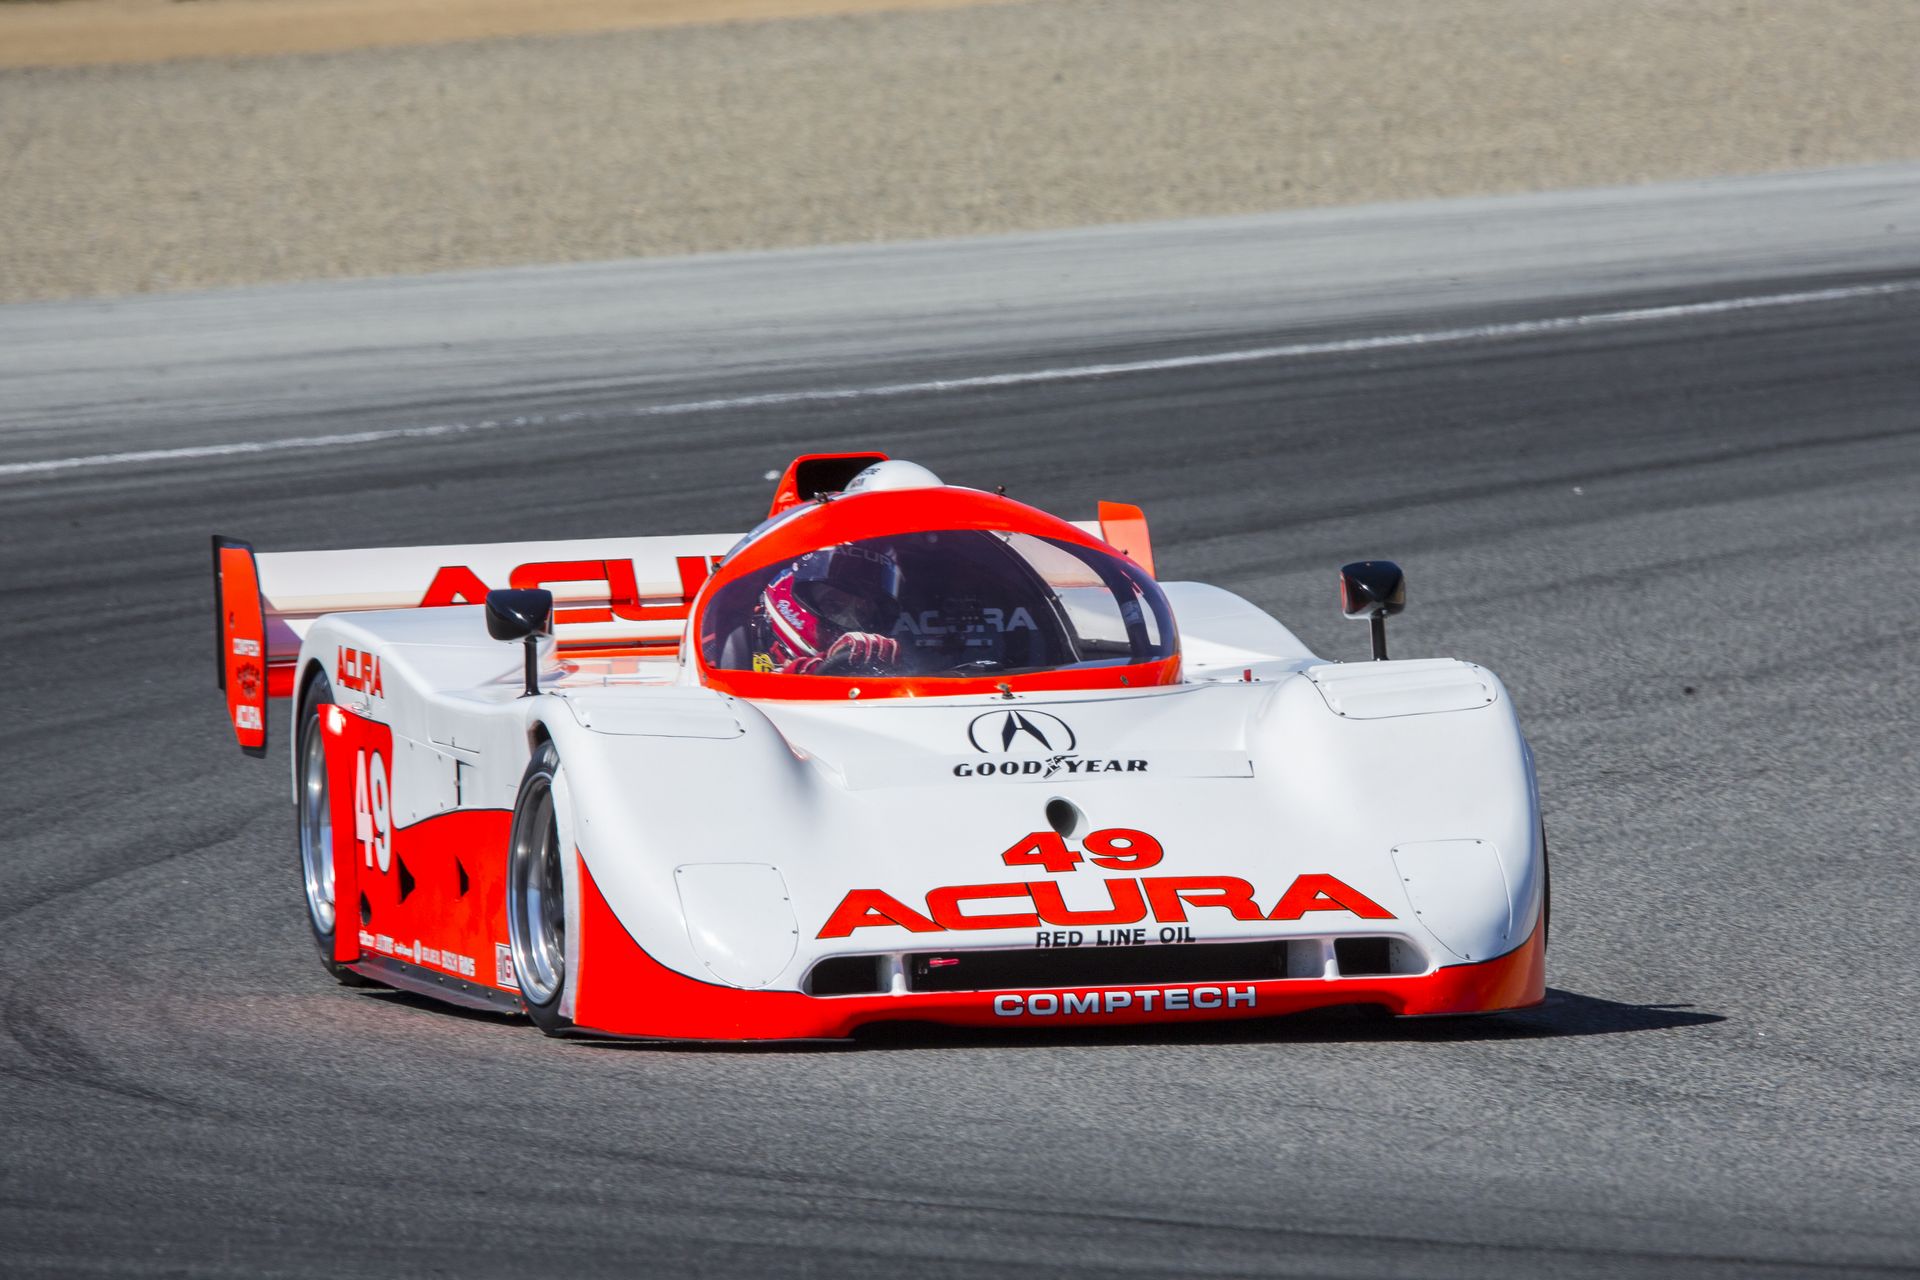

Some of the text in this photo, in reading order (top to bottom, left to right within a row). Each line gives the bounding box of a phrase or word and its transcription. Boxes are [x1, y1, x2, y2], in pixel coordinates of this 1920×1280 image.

[419, 555, 726, 624] ACU
[337, 645, 384, 699] ACURA
[355, 748, 391, 875] 49
[1001, 827, 1164, 873] 49
[815, 873, 1399, 940] ACURA
[1036, 926, 1196, 948] RED LINE OIL
[993, 985, 1256, 1017] COMPTECH
